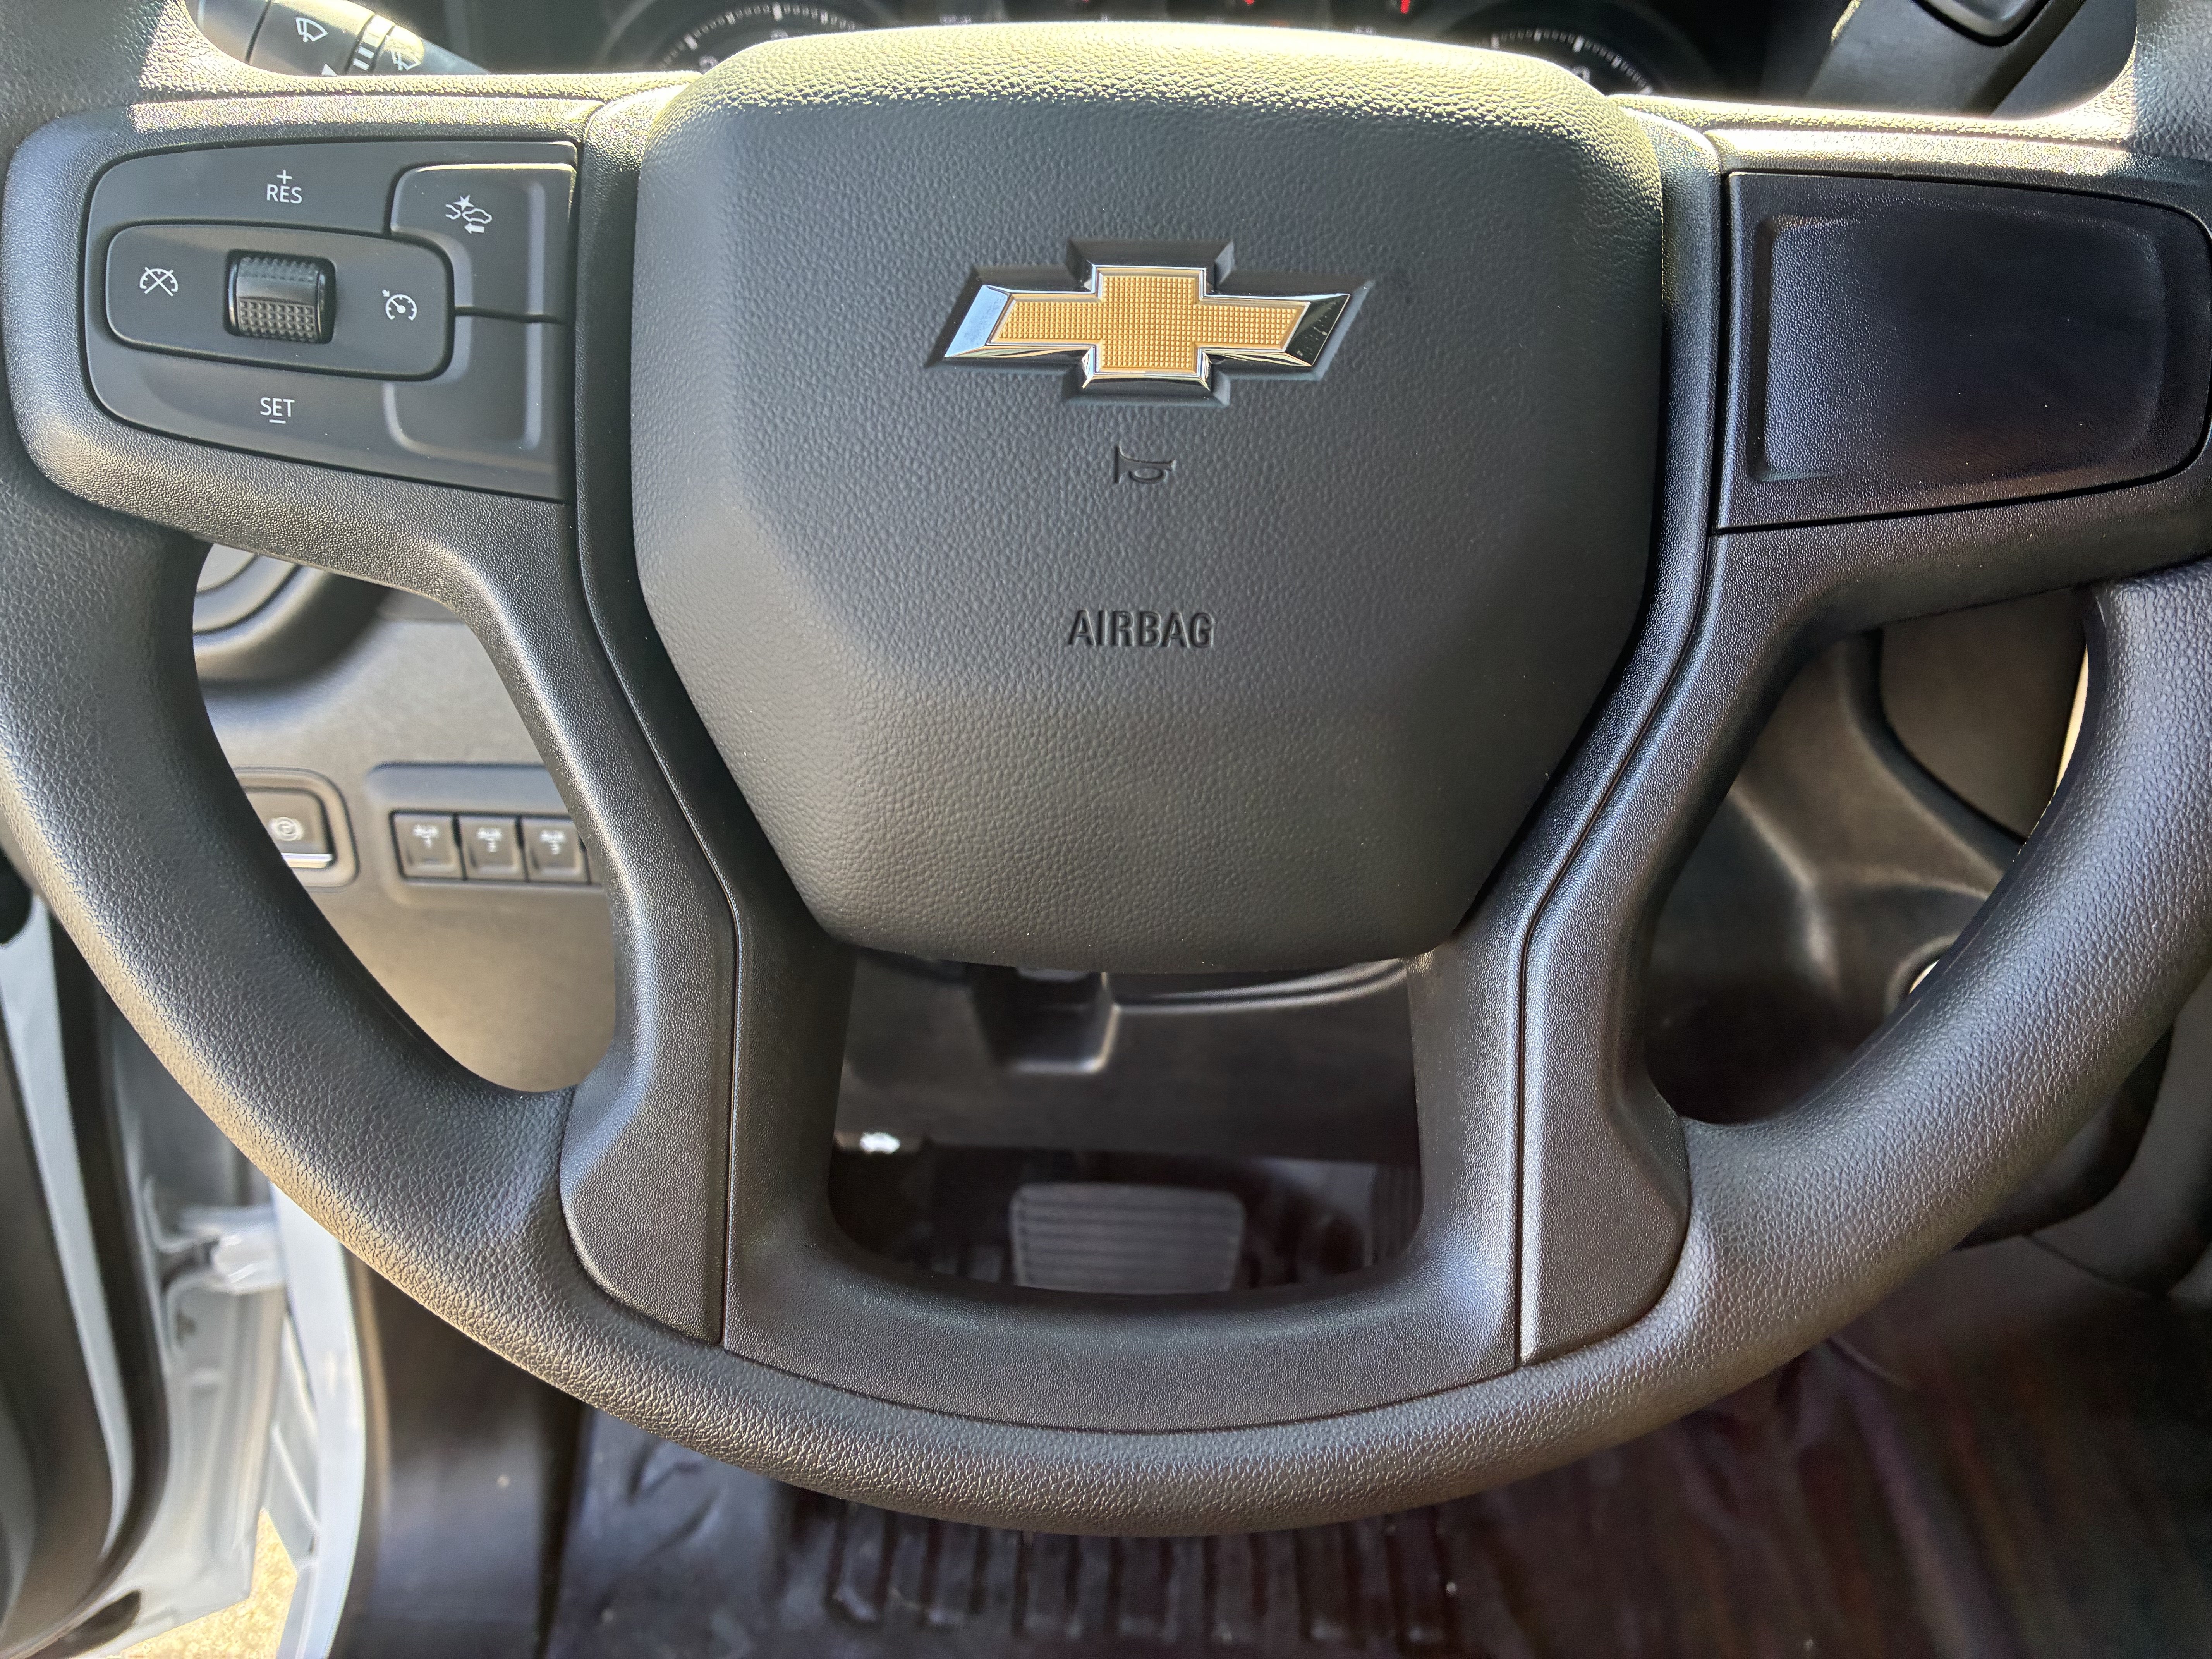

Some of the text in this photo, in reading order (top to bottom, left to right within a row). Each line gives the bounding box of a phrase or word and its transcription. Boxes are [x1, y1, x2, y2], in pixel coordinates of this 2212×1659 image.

[266, 184, 302, 204] RES
[260, 397, 295, 417] SET
[1067, 608, 1215, 649] AIRBAG
